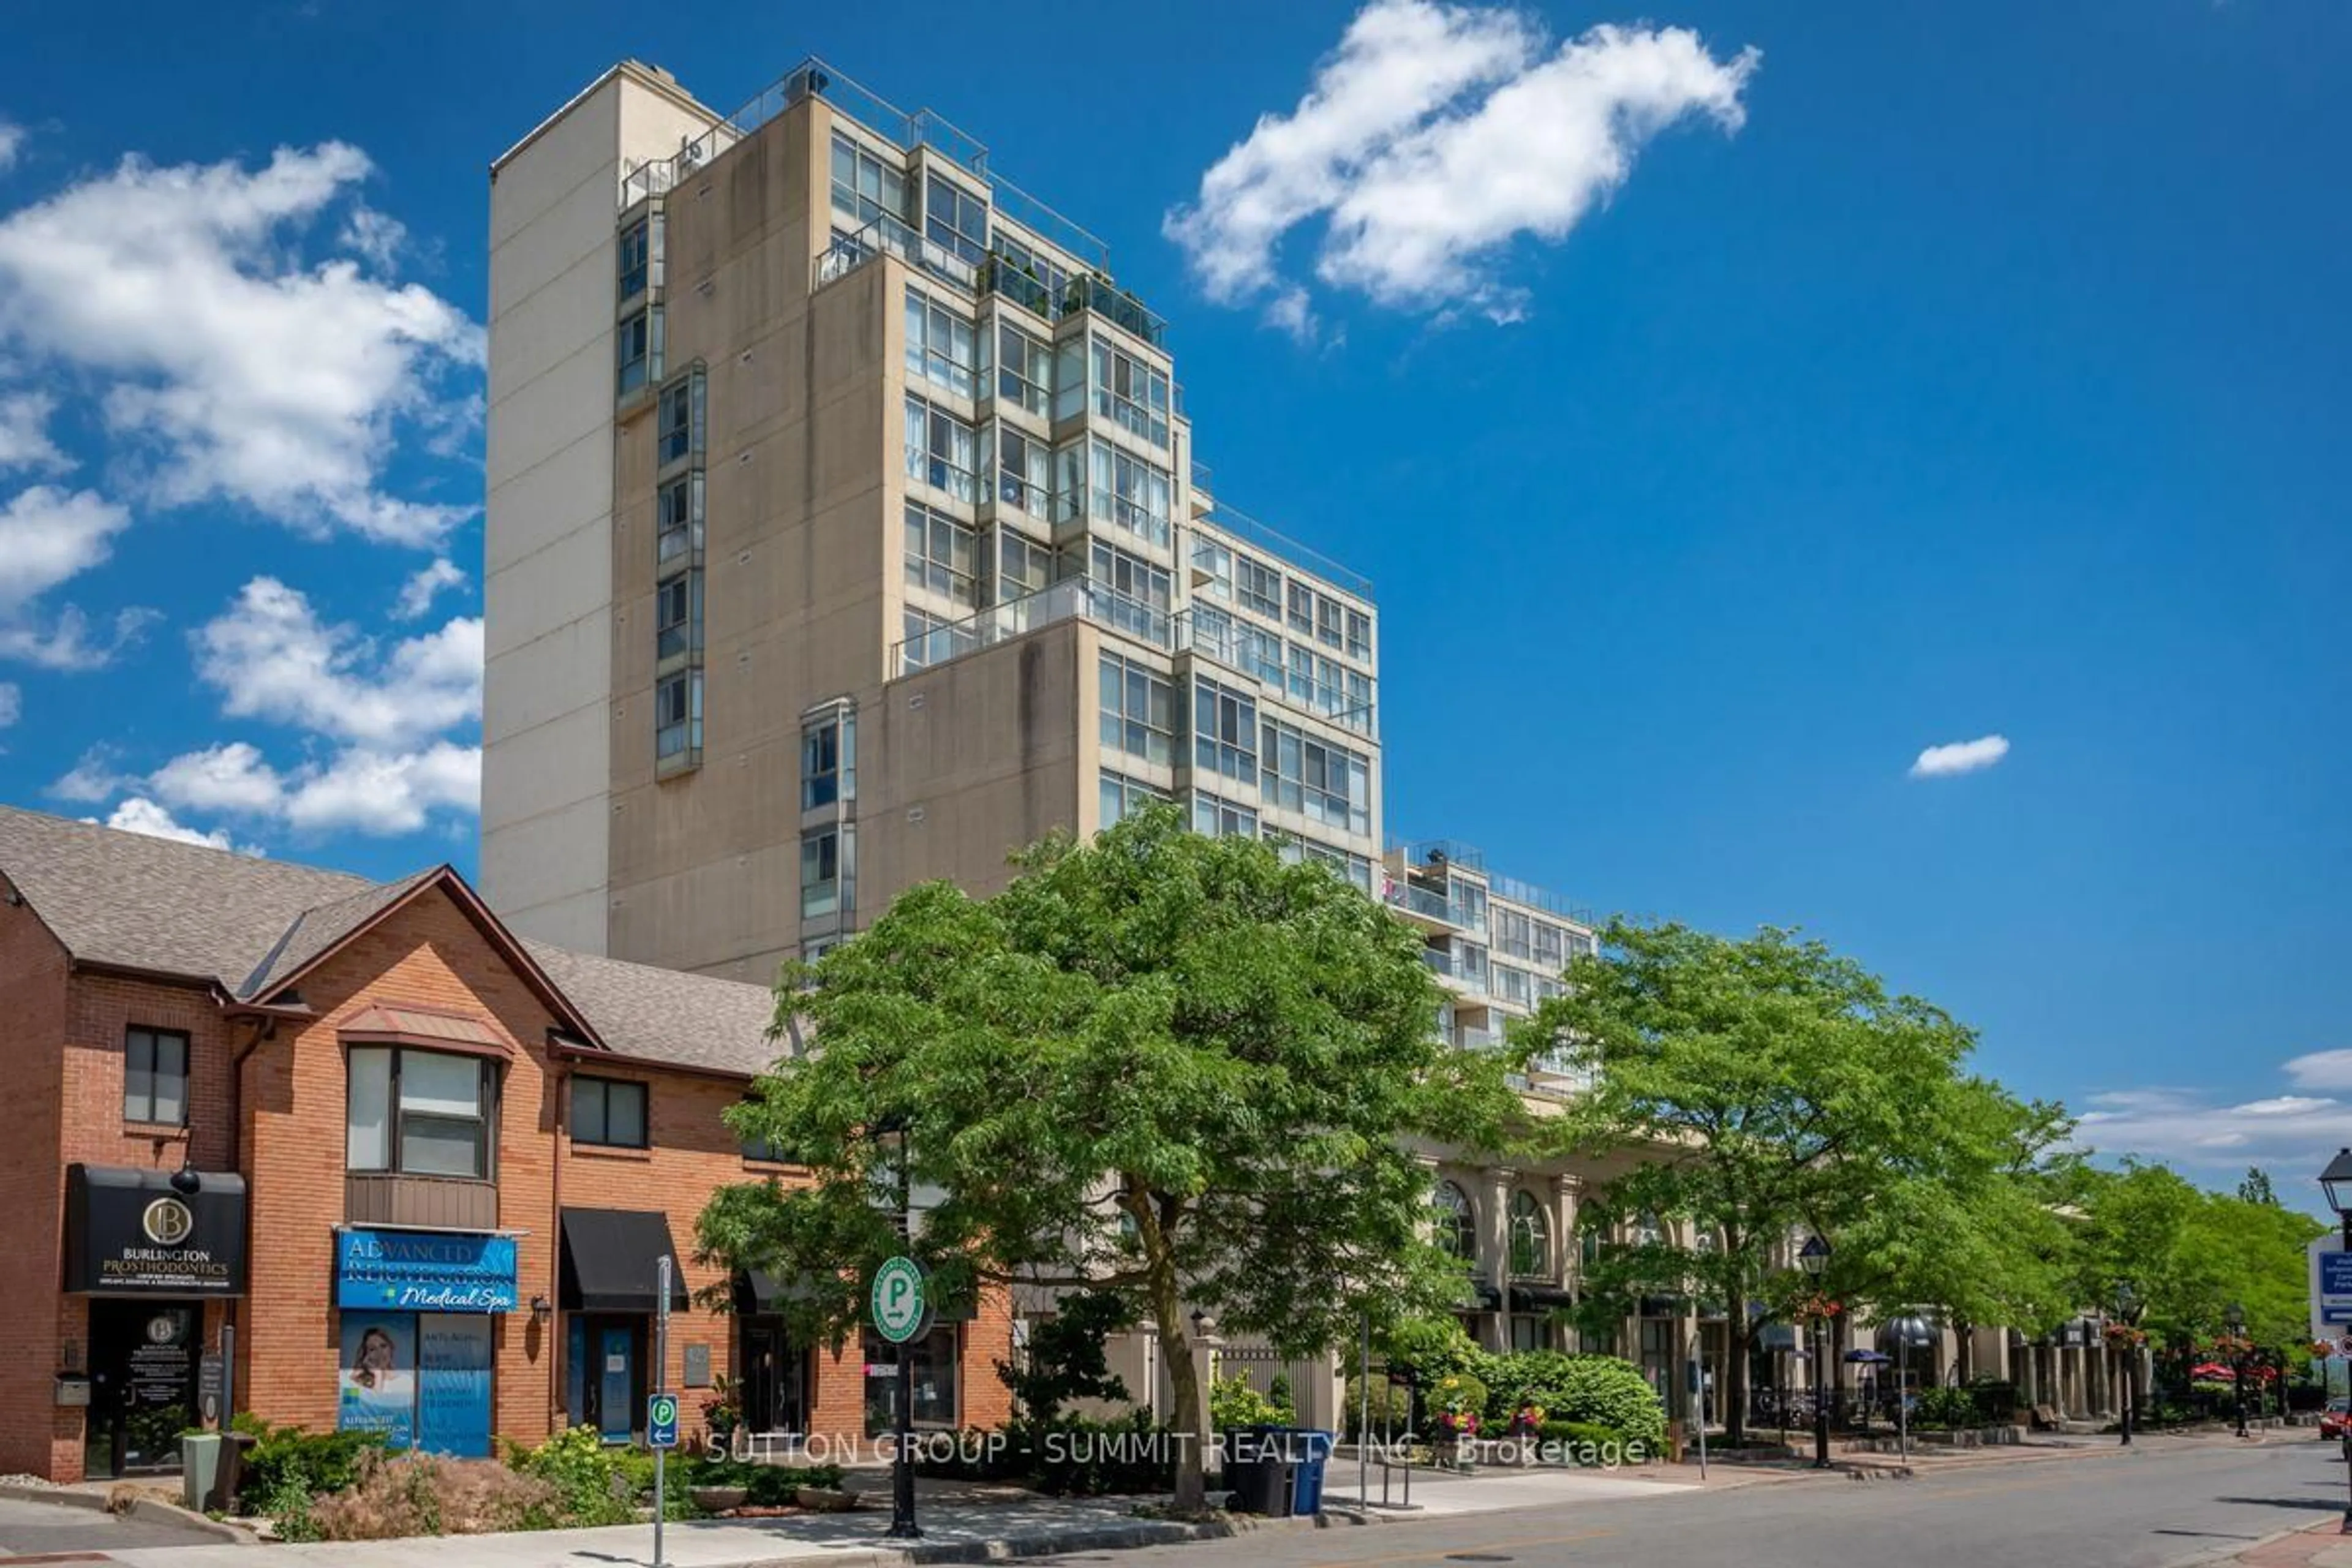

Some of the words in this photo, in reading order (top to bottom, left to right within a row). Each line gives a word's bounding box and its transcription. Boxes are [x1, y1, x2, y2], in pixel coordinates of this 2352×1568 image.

[123, 1248, 210, 1262] BURLINGTON
[349, 1237, 472, 1261] ADVANCED
[103, 1260, 228, 1275] PROSTHODONTICS
[399, 1285, 477, 1307] Medical
[477, 1287, 511, 1314] Spa
[890, 1278, 908, 1307] P
[658, 1404, 669, 1420] P
